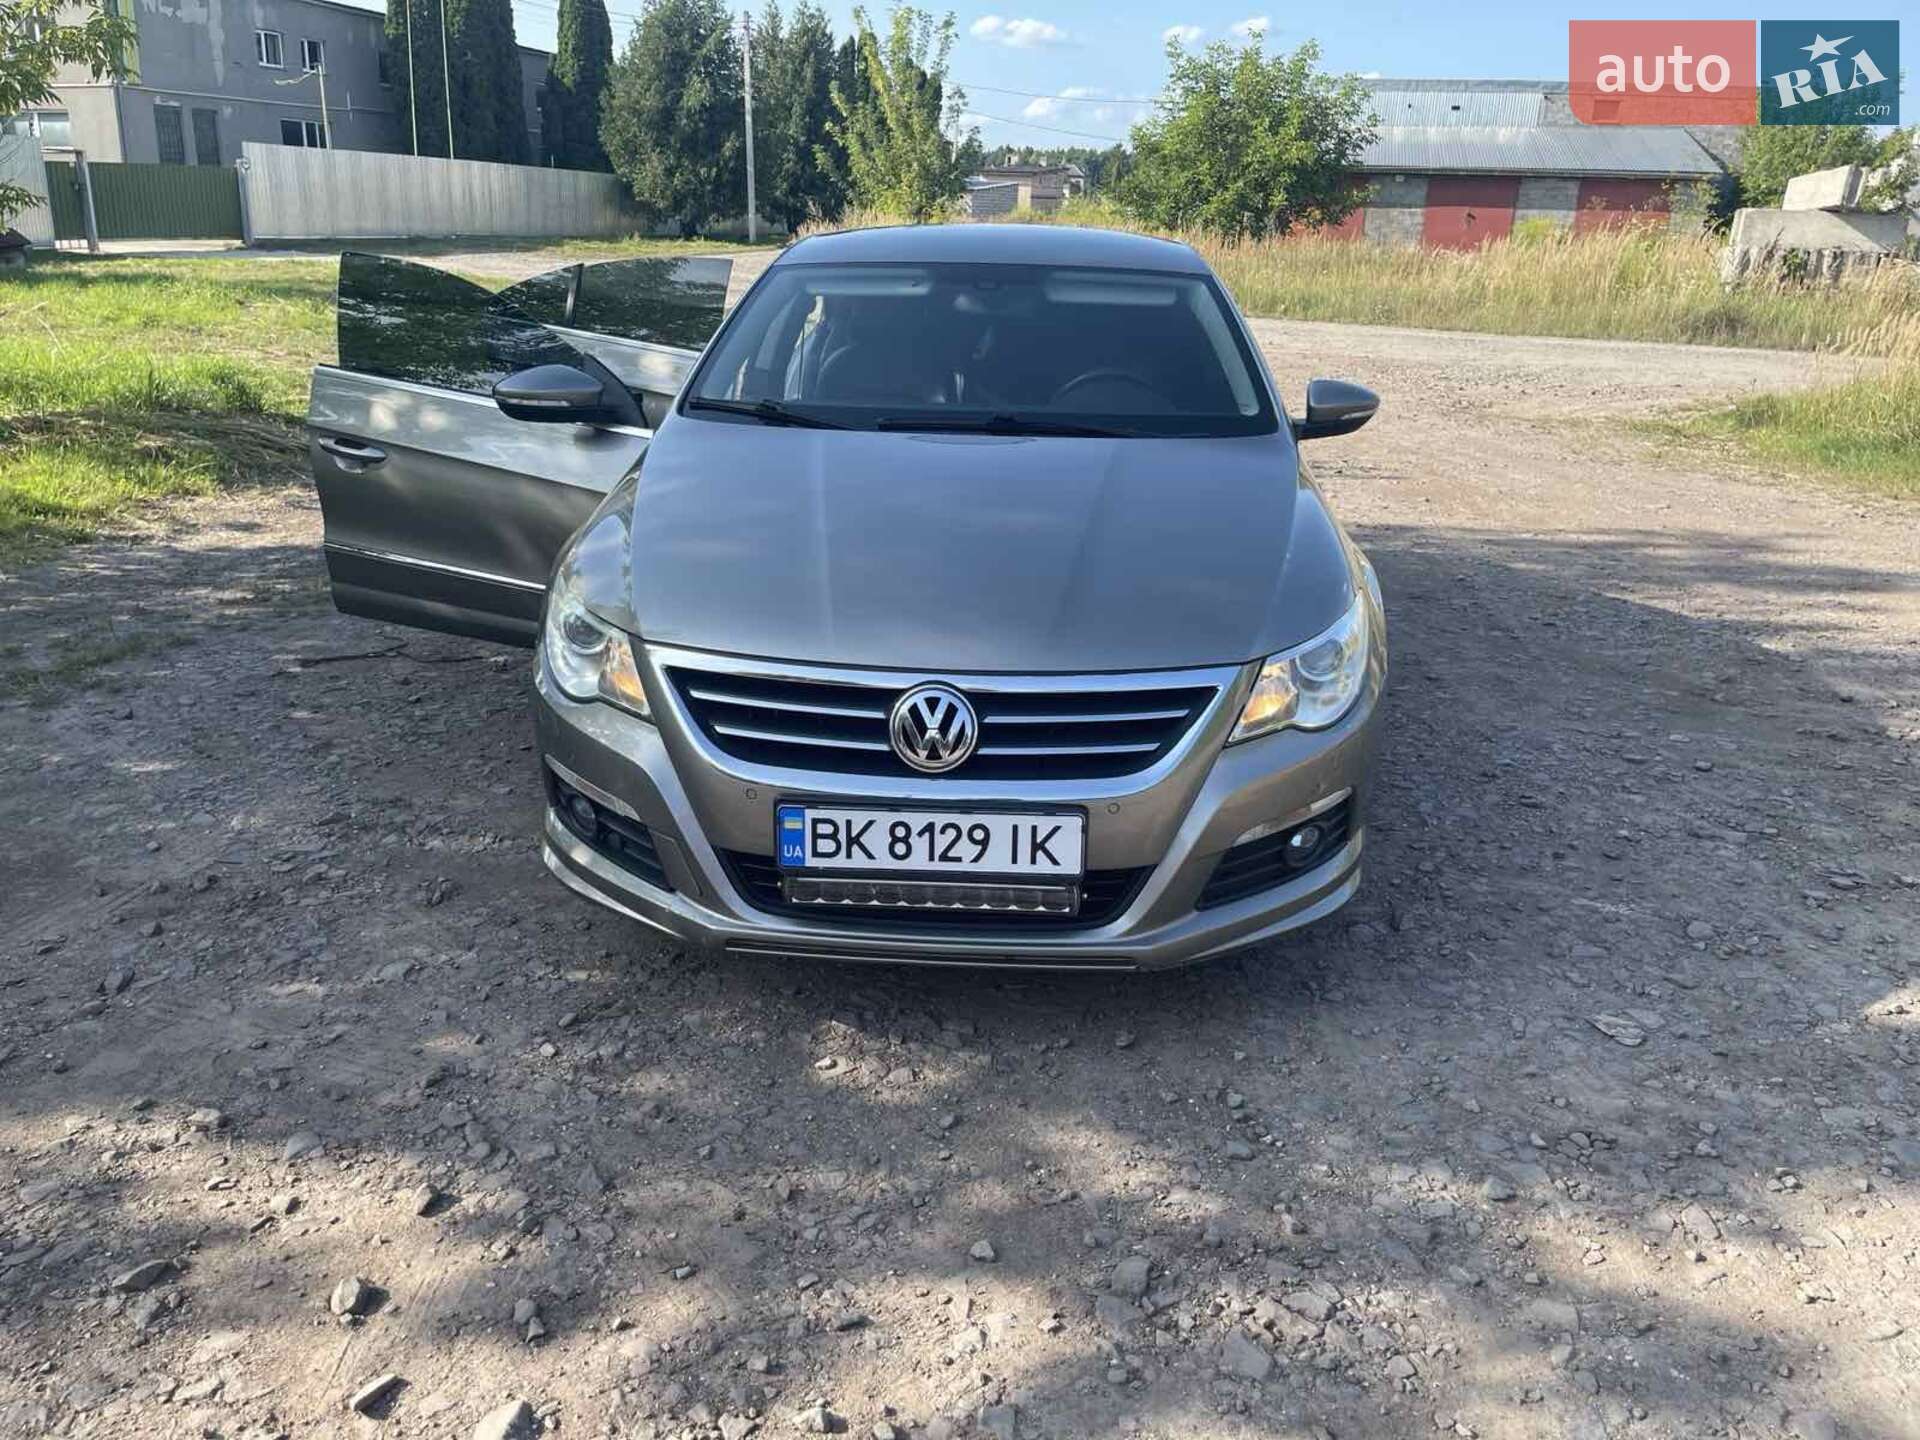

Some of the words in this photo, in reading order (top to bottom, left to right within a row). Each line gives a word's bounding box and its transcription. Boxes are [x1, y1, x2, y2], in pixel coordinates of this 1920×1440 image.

[894, 689, 972, 767] VW
[783, 844, 804, 859] UA
[810, 817, 877, 861] BK
[888, 820, 991, 864] 8129
[1011, 823, 1063, 867] IK
